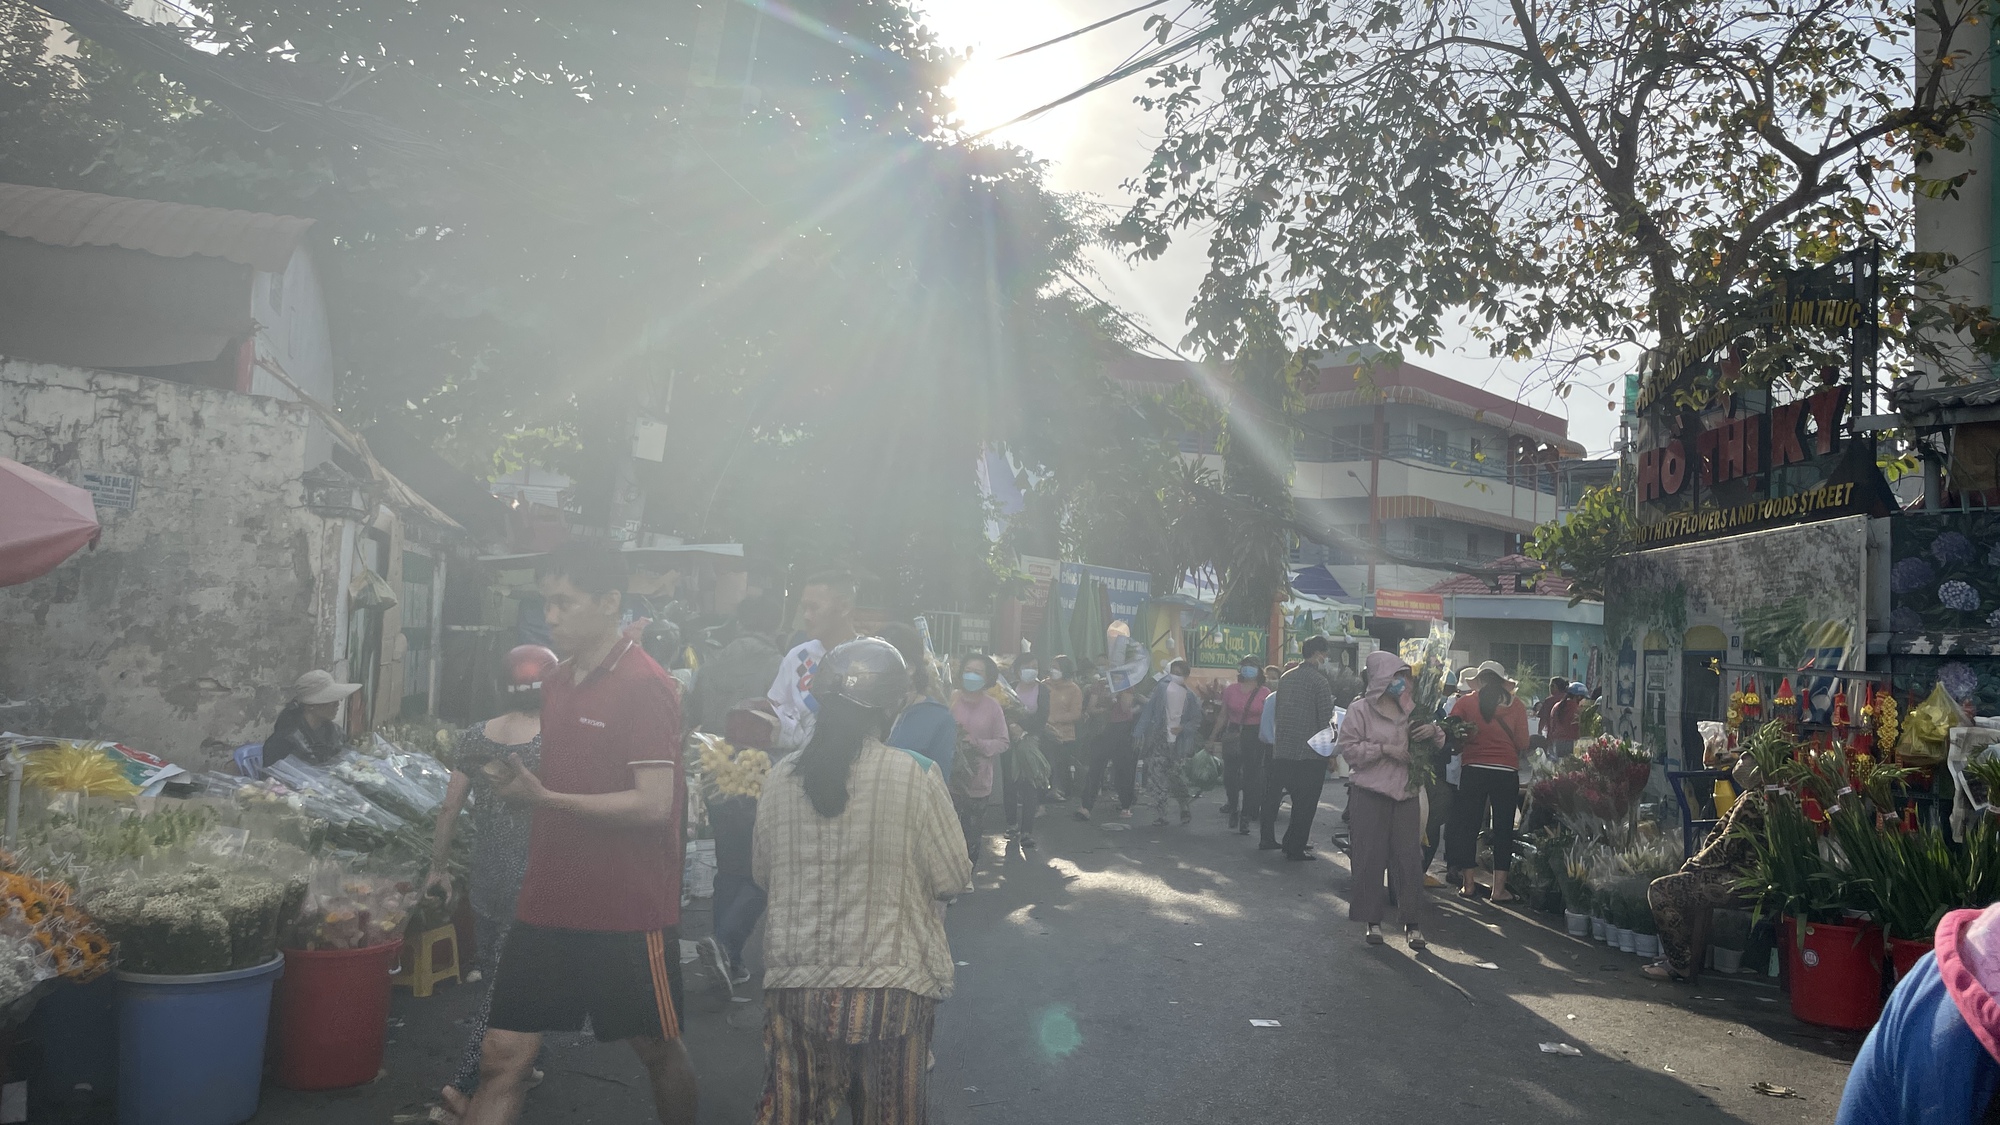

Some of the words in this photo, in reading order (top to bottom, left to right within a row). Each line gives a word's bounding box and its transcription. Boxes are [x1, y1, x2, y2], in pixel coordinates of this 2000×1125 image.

[1679, 508, 1728, 536] FLOWERS
[1729, 503, 1756, 528] AND
[1757, 495, 1798, 521] FOODS
[1798, 481, 1855, 514] STREET
